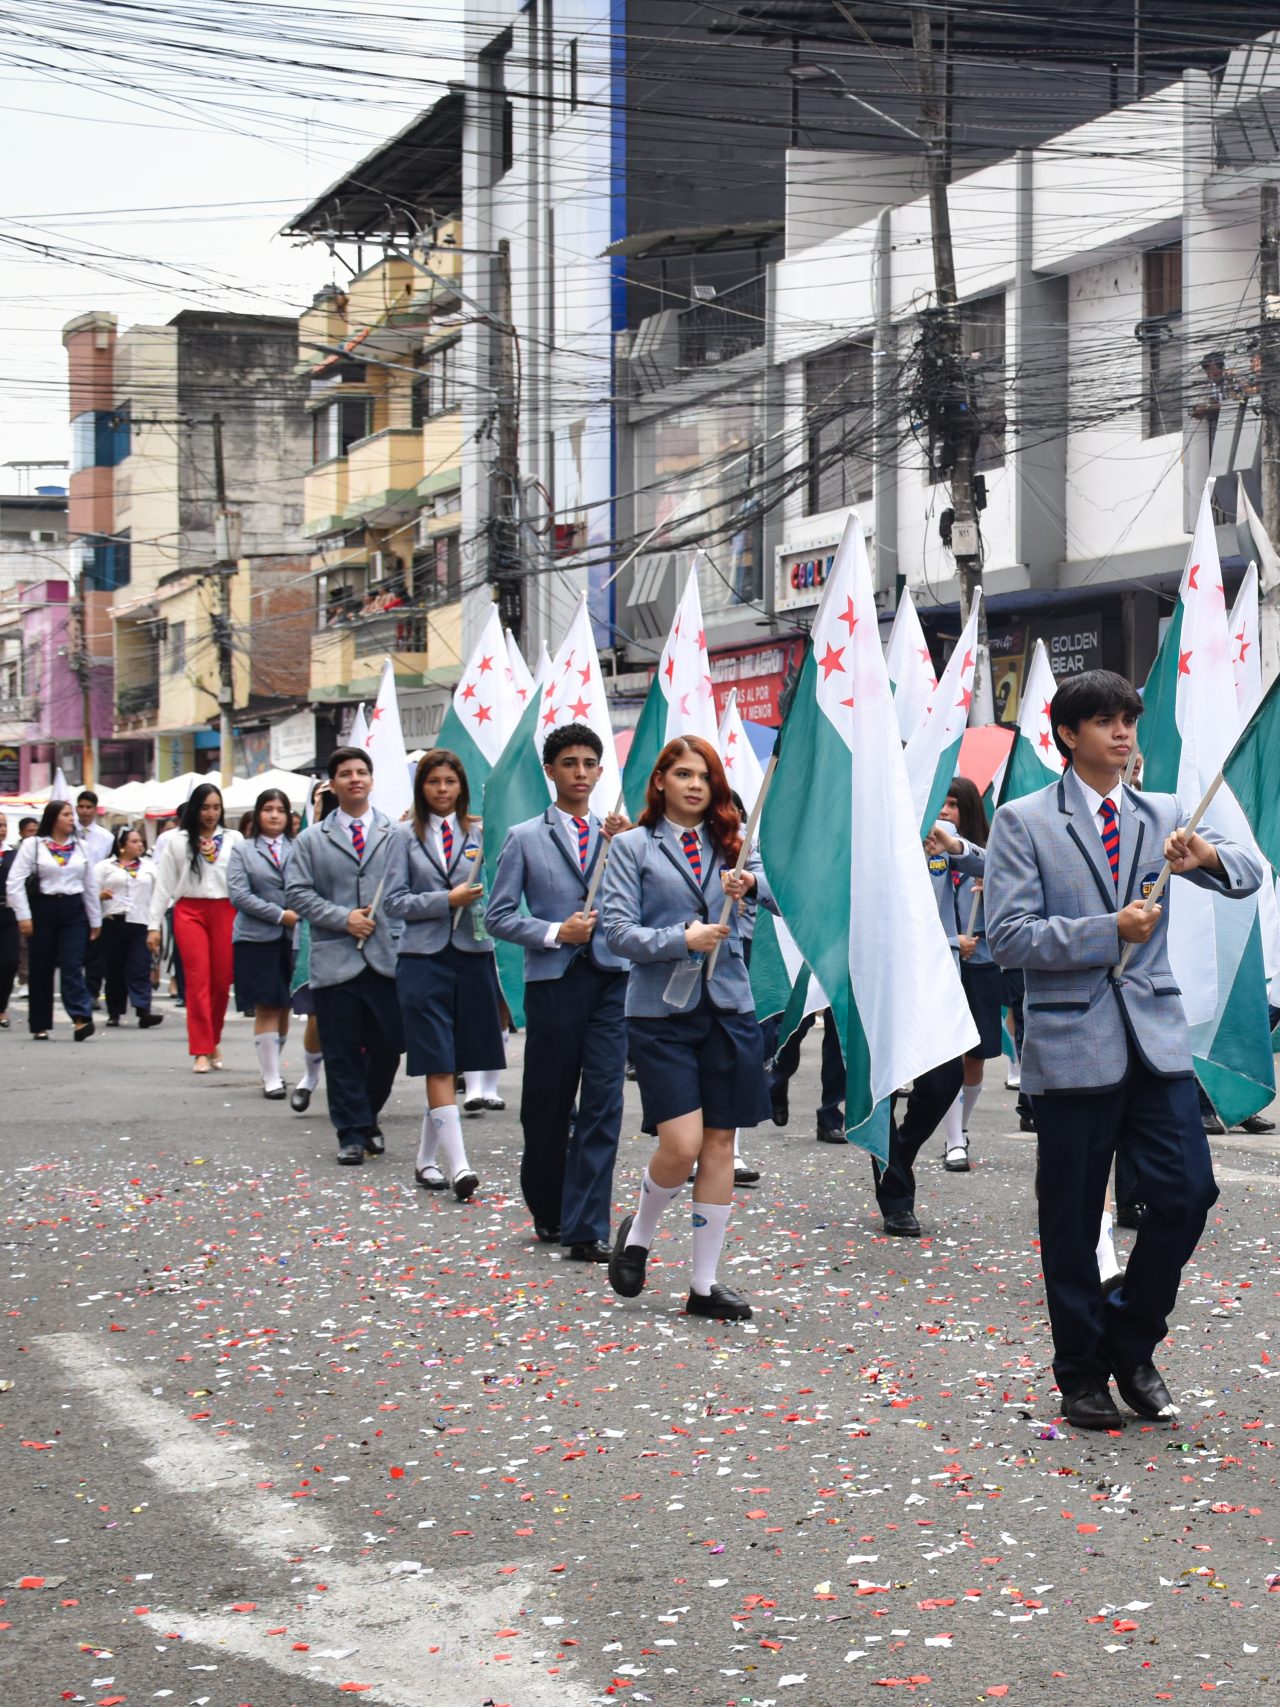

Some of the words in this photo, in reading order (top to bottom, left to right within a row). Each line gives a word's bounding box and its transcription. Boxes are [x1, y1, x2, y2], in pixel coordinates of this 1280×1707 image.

[791, 559, 824, 590] COOL
[1051, 631, 1097, 653] GOLDEN
[740, 648, 781, 680] MILAGRO
[1051, 654, 1084, 673] BEAR
[747, 687, 755, 702] AL
[756, 685, 769, 701] POR
[749, 703, 772, 720] MENOR
